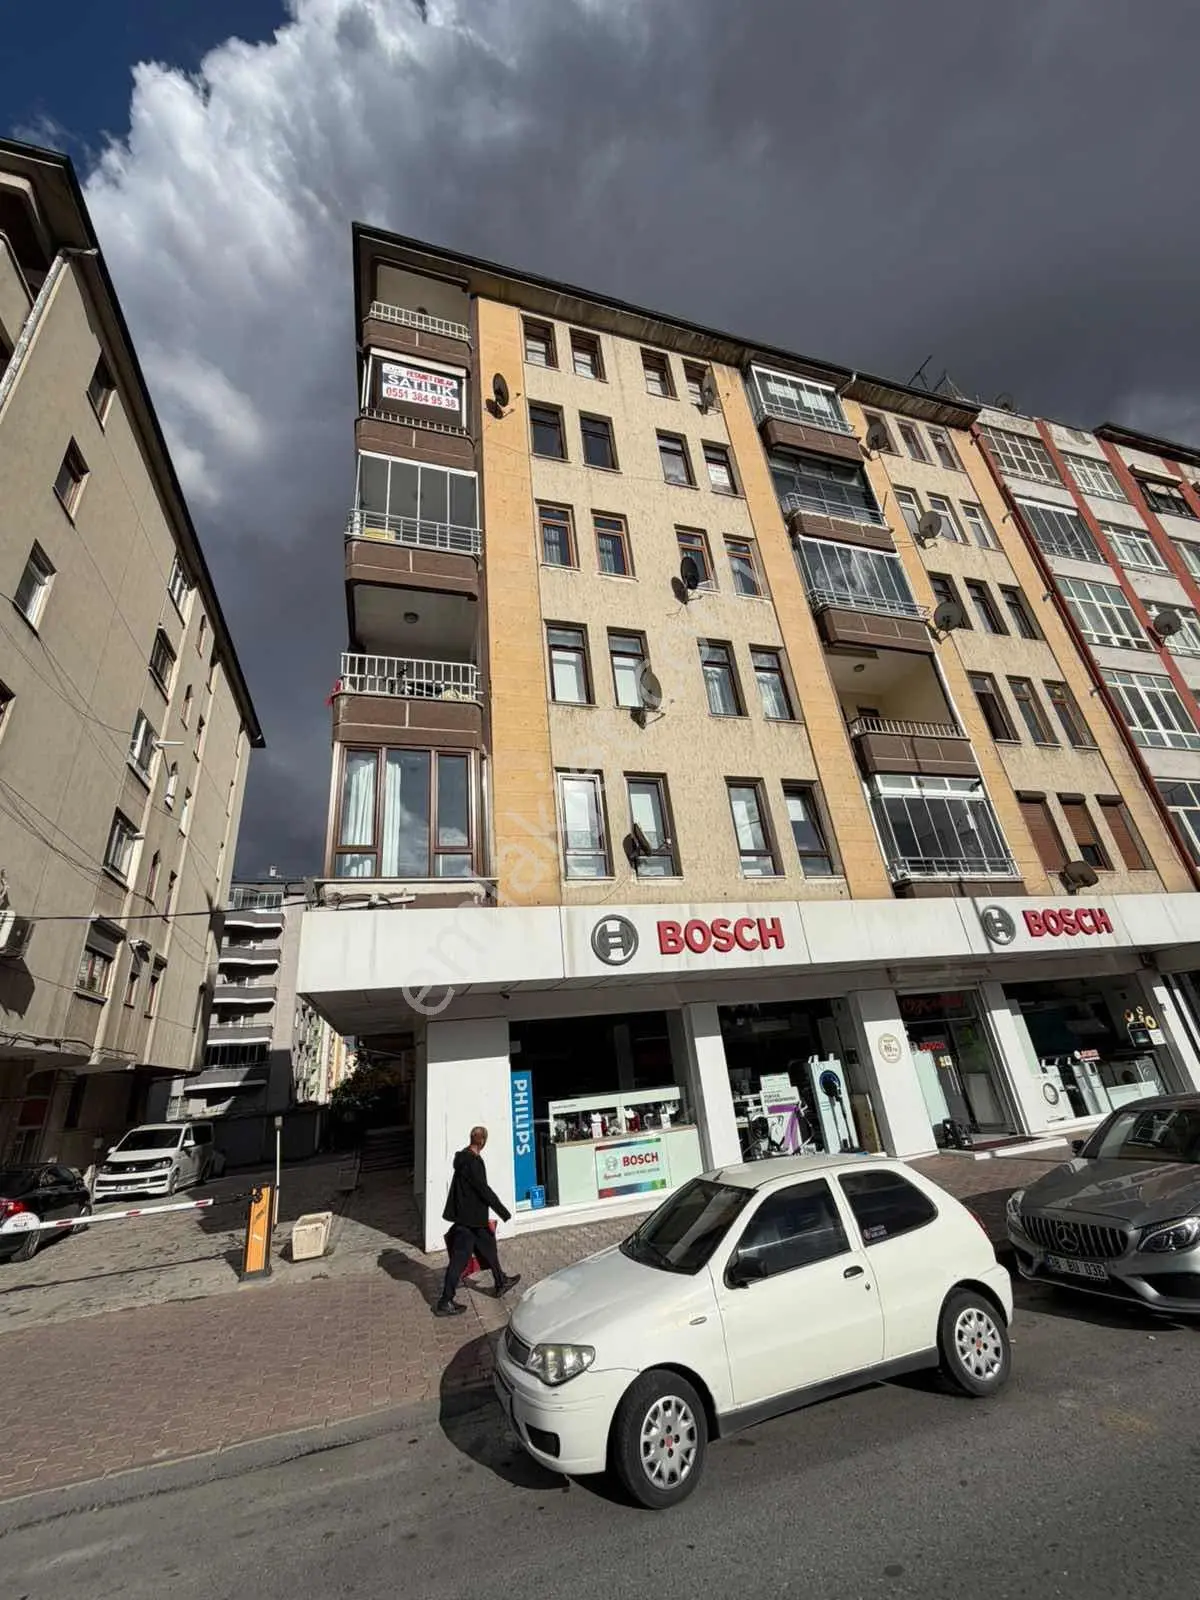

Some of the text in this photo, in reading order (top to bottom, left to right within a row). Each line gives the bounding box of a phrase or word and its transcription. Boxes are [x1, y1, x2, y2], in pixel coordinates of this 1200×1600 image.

[386, 386, 408, 399] 0551
[388, 374, 454, 397] SATILIK
[656, 917, 785, 955] BOSCH
[1022, 908, 1114, 938] BOSCH
[514, 1079, 531, 1156] PHILIPS
[622, 1152, 659, 1167] BOSCH
